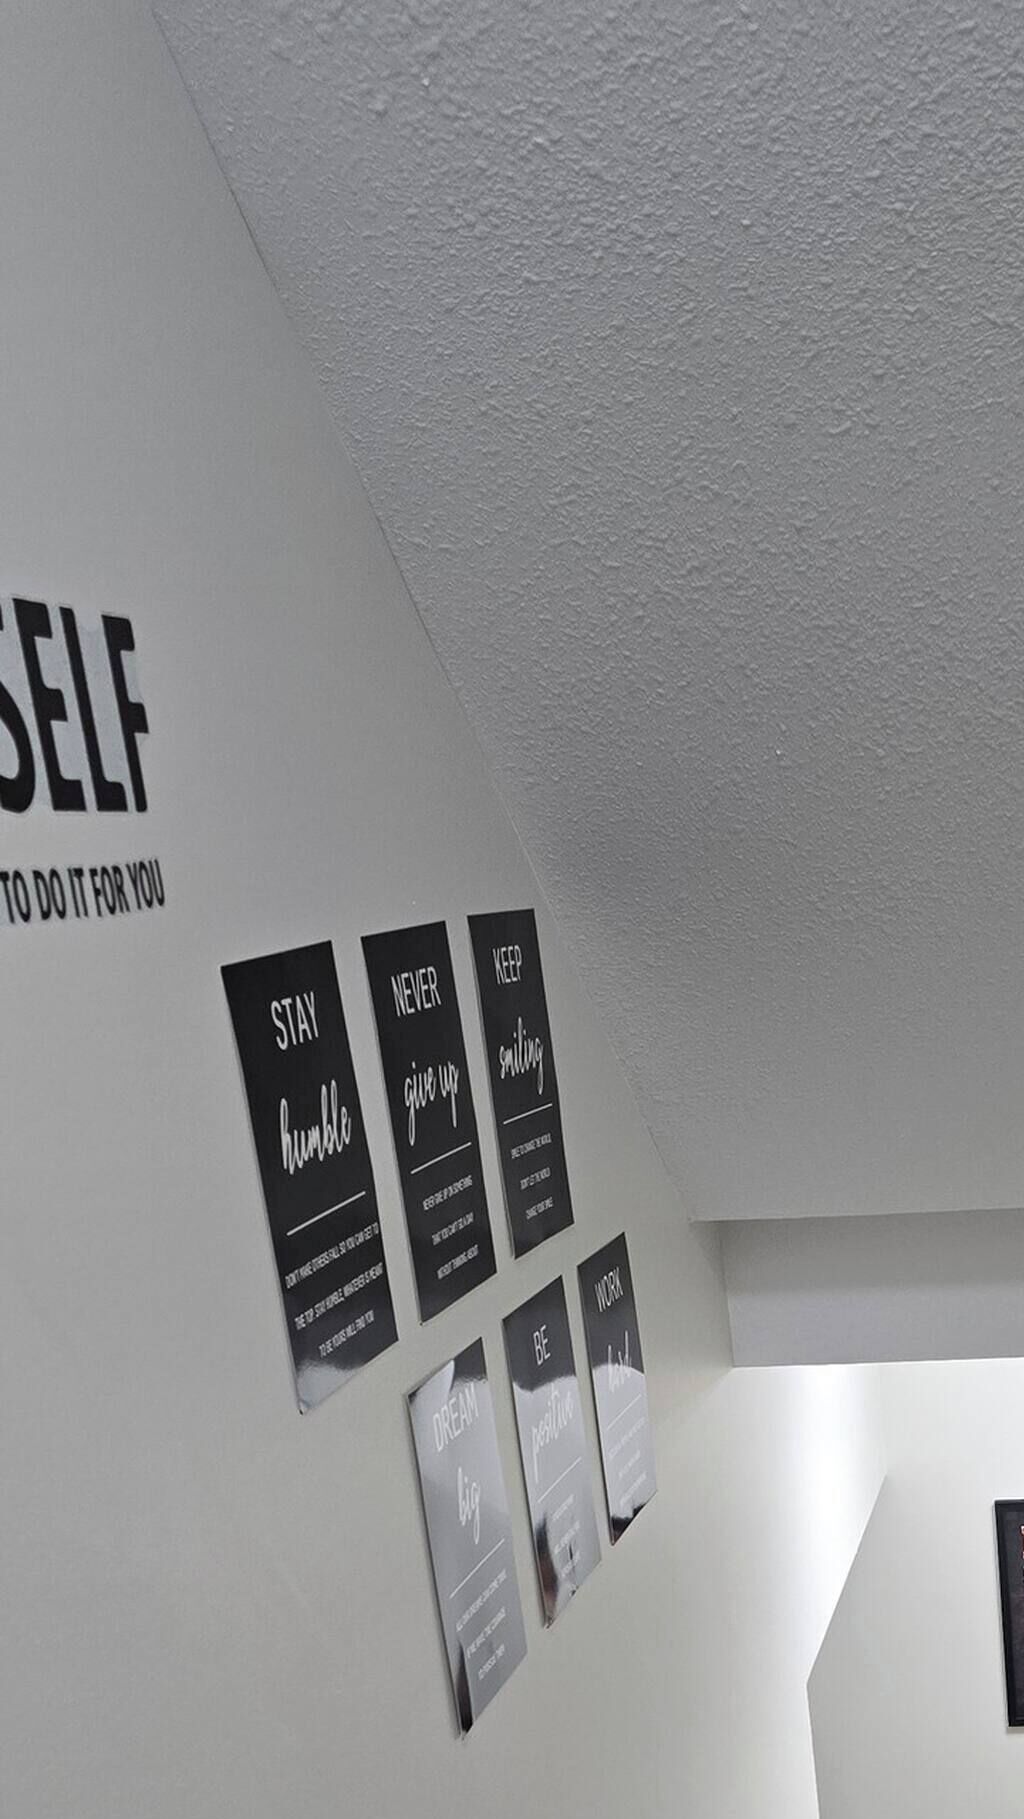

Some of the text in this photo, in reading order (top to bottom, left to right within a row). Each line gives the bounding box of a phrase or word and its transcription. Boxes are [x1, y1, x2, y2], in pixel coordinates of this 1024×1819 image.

[0, 858, 165, 924] TO DO IT FOR YOU
[391, 965, 442, 1017] NEVER
[493, 944, 523, 985] KEEP
[270, 991, 321, 1052] STAY
[499, 1016, 544, 1095] smiling
[280, 1079, 351, 1175] humble
[403, 1060, 459, 1146] give up
[594, 1266, 624, 1313] WORK
[533, 1323, 551, 1365] BE
[433, 1383, 480, 1453] DREAM
[456, 1466, 481, 1545] big
